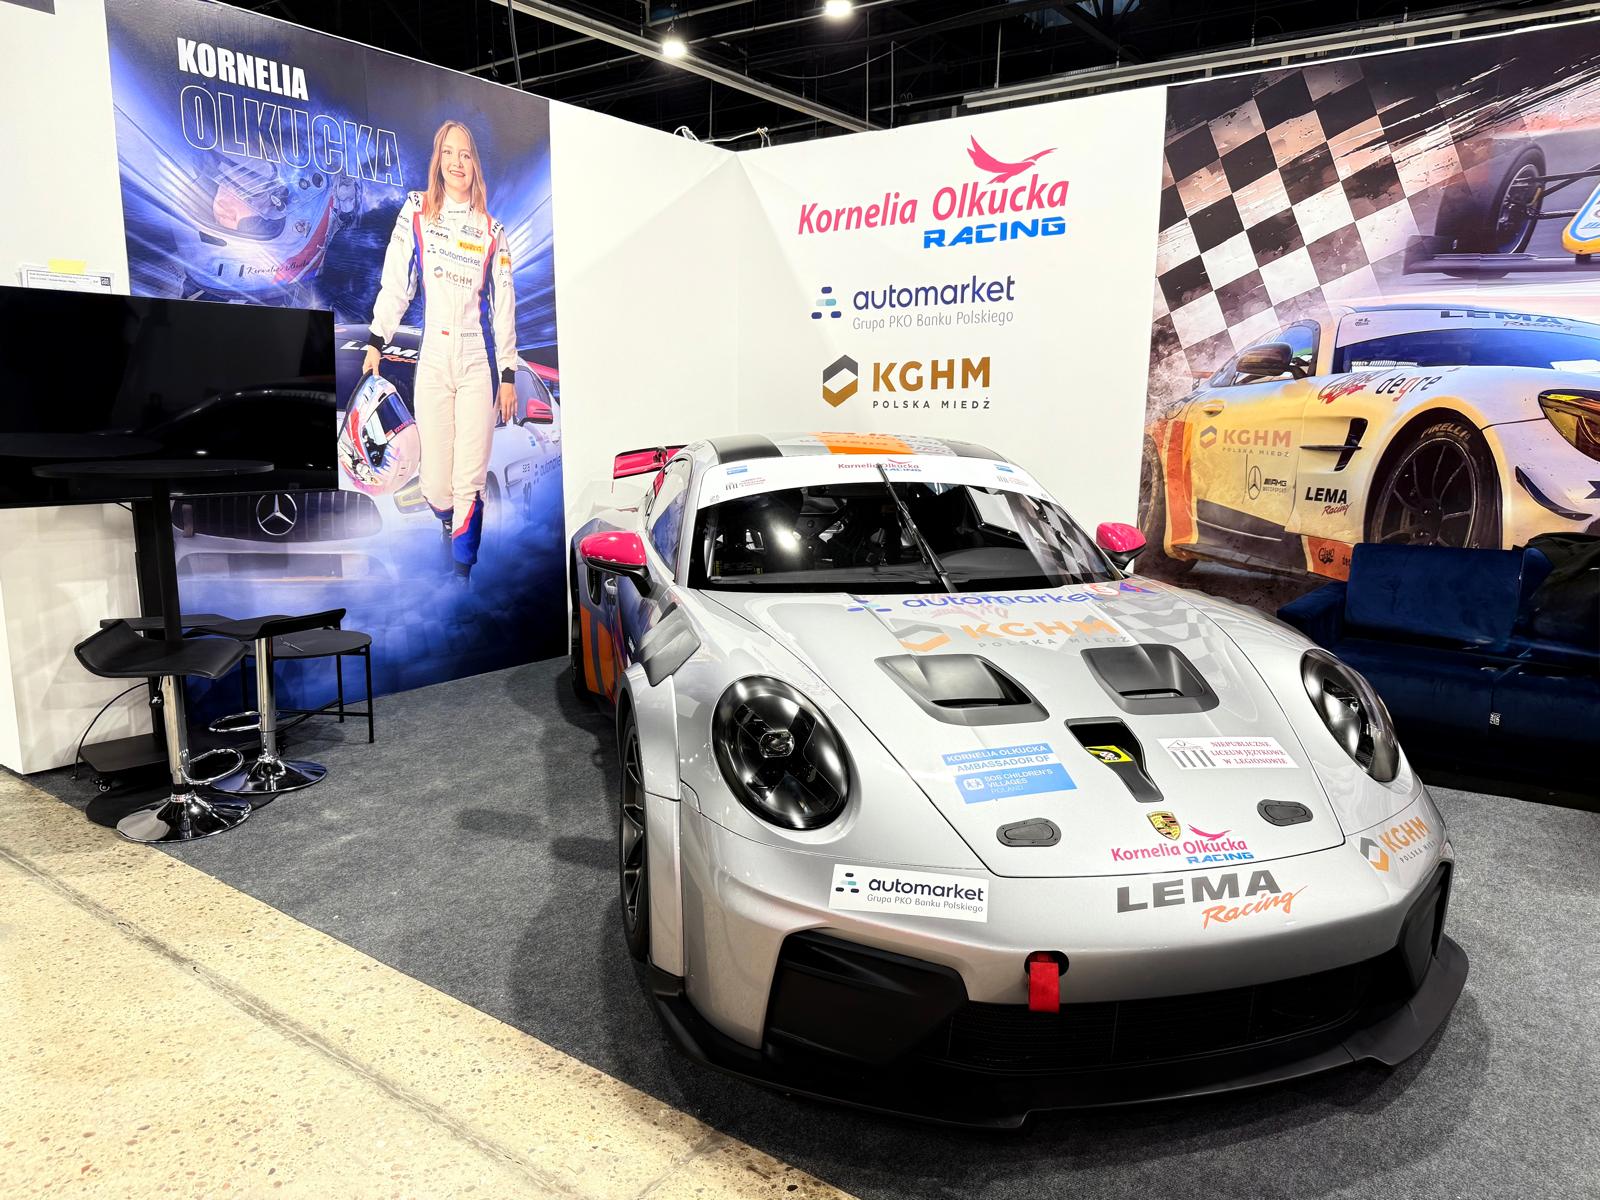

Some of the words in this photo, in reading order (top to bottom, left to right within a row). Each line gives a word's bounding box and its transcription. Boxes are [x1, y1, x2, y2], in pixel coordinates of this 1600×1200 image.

[177, 37, 309, 101] KORNELIA
[180, 85, 404, 187] OLKUCKA
[798, 191, 918, 235] Kornelia
[932, 173, 1070, 222] Olkucka
[923, 216, 1066, 249] RACING
[438, 248, 481, 267] automarket
[445, 270, 473, 286] KGHM
[853, 275, 1015, 311] automarket
[852, 317, 885, 332] Grupa
[889, 314, 912, 328] PKO
[916, 312, 952, 327] Banku
[956, 309, 1014, 327] Polskiego
[1440, 310, 1564, 325] LEMA
[872, 356, 991, 393] KGHM
[1375, 373, 1443, 402] degre
[872, 400, 930, 409] POLSKA
[1223, 429, 1292, 448] KGHM
[1420, 422, 1468, 439] PIRELLI
[1222, 447, 1254, 455] POLSKA
[1305, 487, 1348, 504] LEMA
[1322, 502, 1354, 517] Racing
[902, 590, 1105, 608] automarket
[960, 617, 1120, 640] KGHM
[977, 638, 1057, 648] POLSKA
[946, 751, 998, 762] KORNELIA
[998, 745, 1048, 756] OLKUCKA
[1210, 748, 1242, 756] LICEUM
[957, 757, 1034, 772] AMBASSADOR
[1035, 754, 1050, 763] OF
[988, 777, 1028, 788] VILLAGES
[1004, 768, 1054, 780] CHILDREN'S
[1378, 815, 1431, 853] KGHM
[1111, 839, 1181, 861] Kornelia
[1183, 835, 1248, 855] Olkucka
[1187, 851, 1255, 865] RACING
[868, 878, 984, 902] automarket
[1116, 870, 1282, 913] LEMA
[867, 893, 892, 904] Grupa
[894, 896, 912, 905] PKO
[914, 899, 941, 908] Banku
[943, 901, 984, 914] Polskiego
[1200, 884, 1309, 930] Racing
